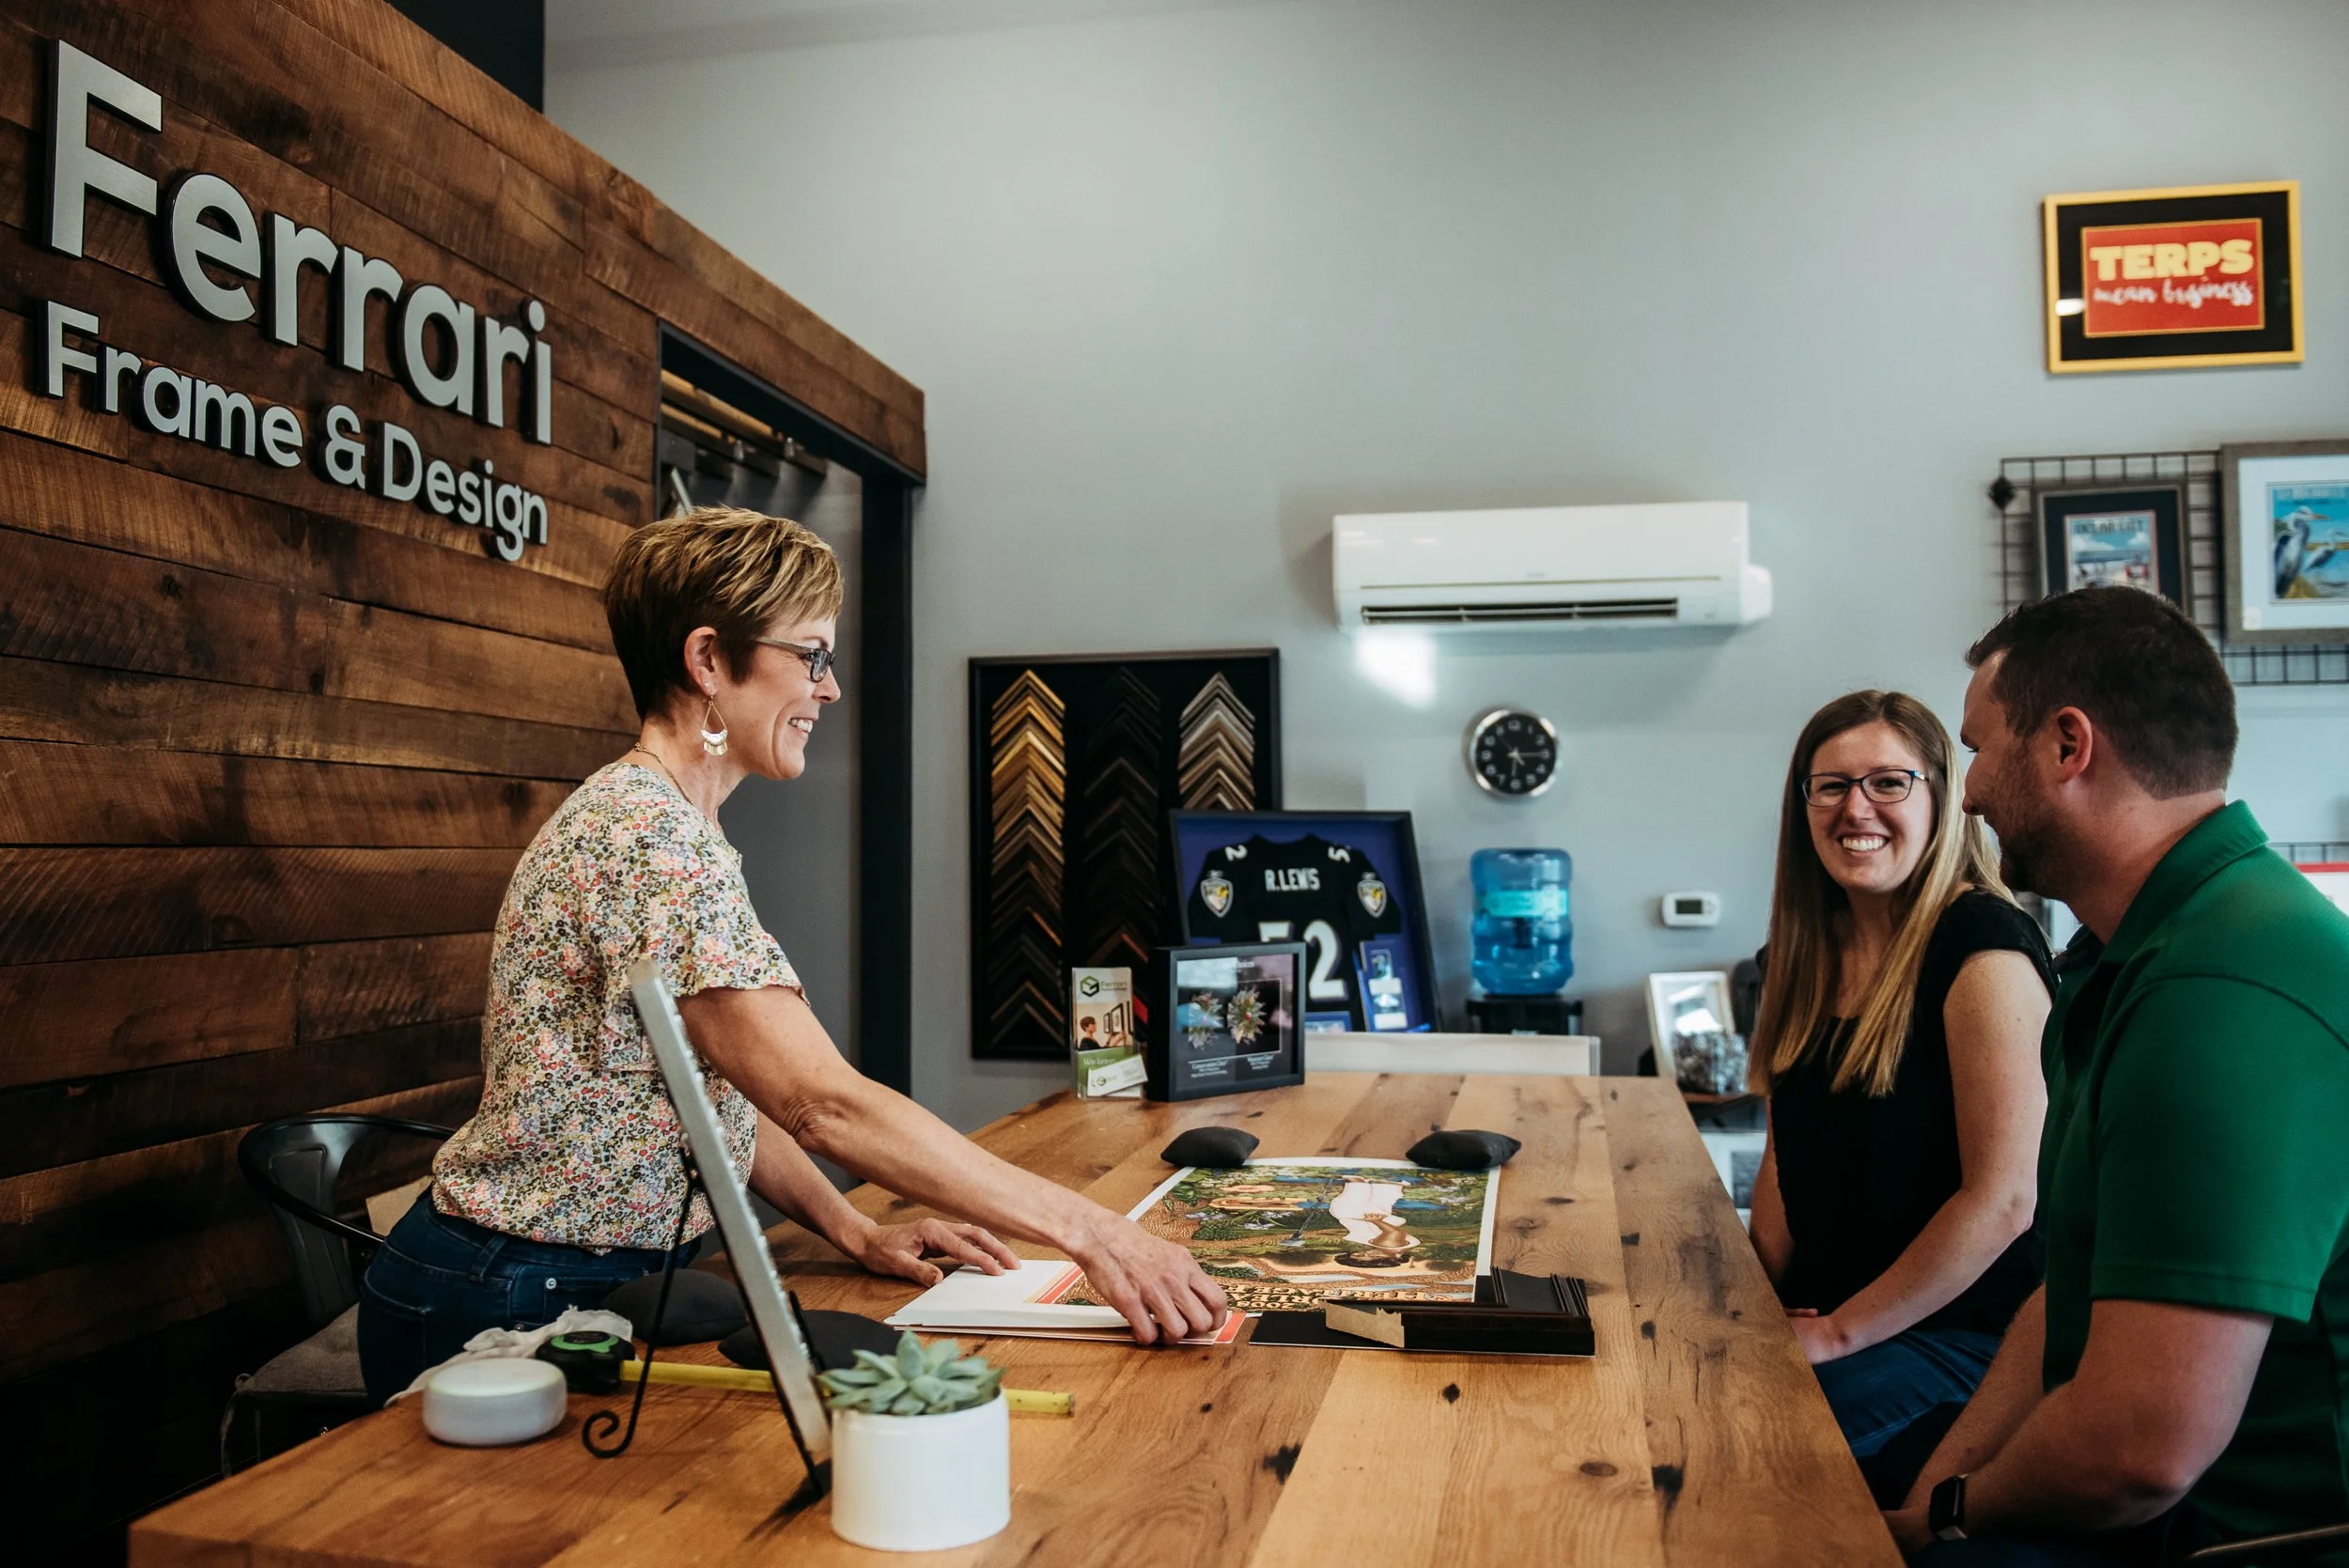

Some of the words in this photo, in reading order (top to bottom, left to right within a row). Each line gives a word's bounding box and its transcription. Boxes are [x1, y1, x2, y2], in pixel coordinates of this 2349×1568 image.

[47, 39, 552, 445] Ferrari
[2089, 239, 2254, 281] TERPS
[40, 301, 303, 468] Frame
[319, 405, 366, 490] &
[379, 422, 548, 562] Design
[1229, 1293, 1341, 1305] ORLEA
